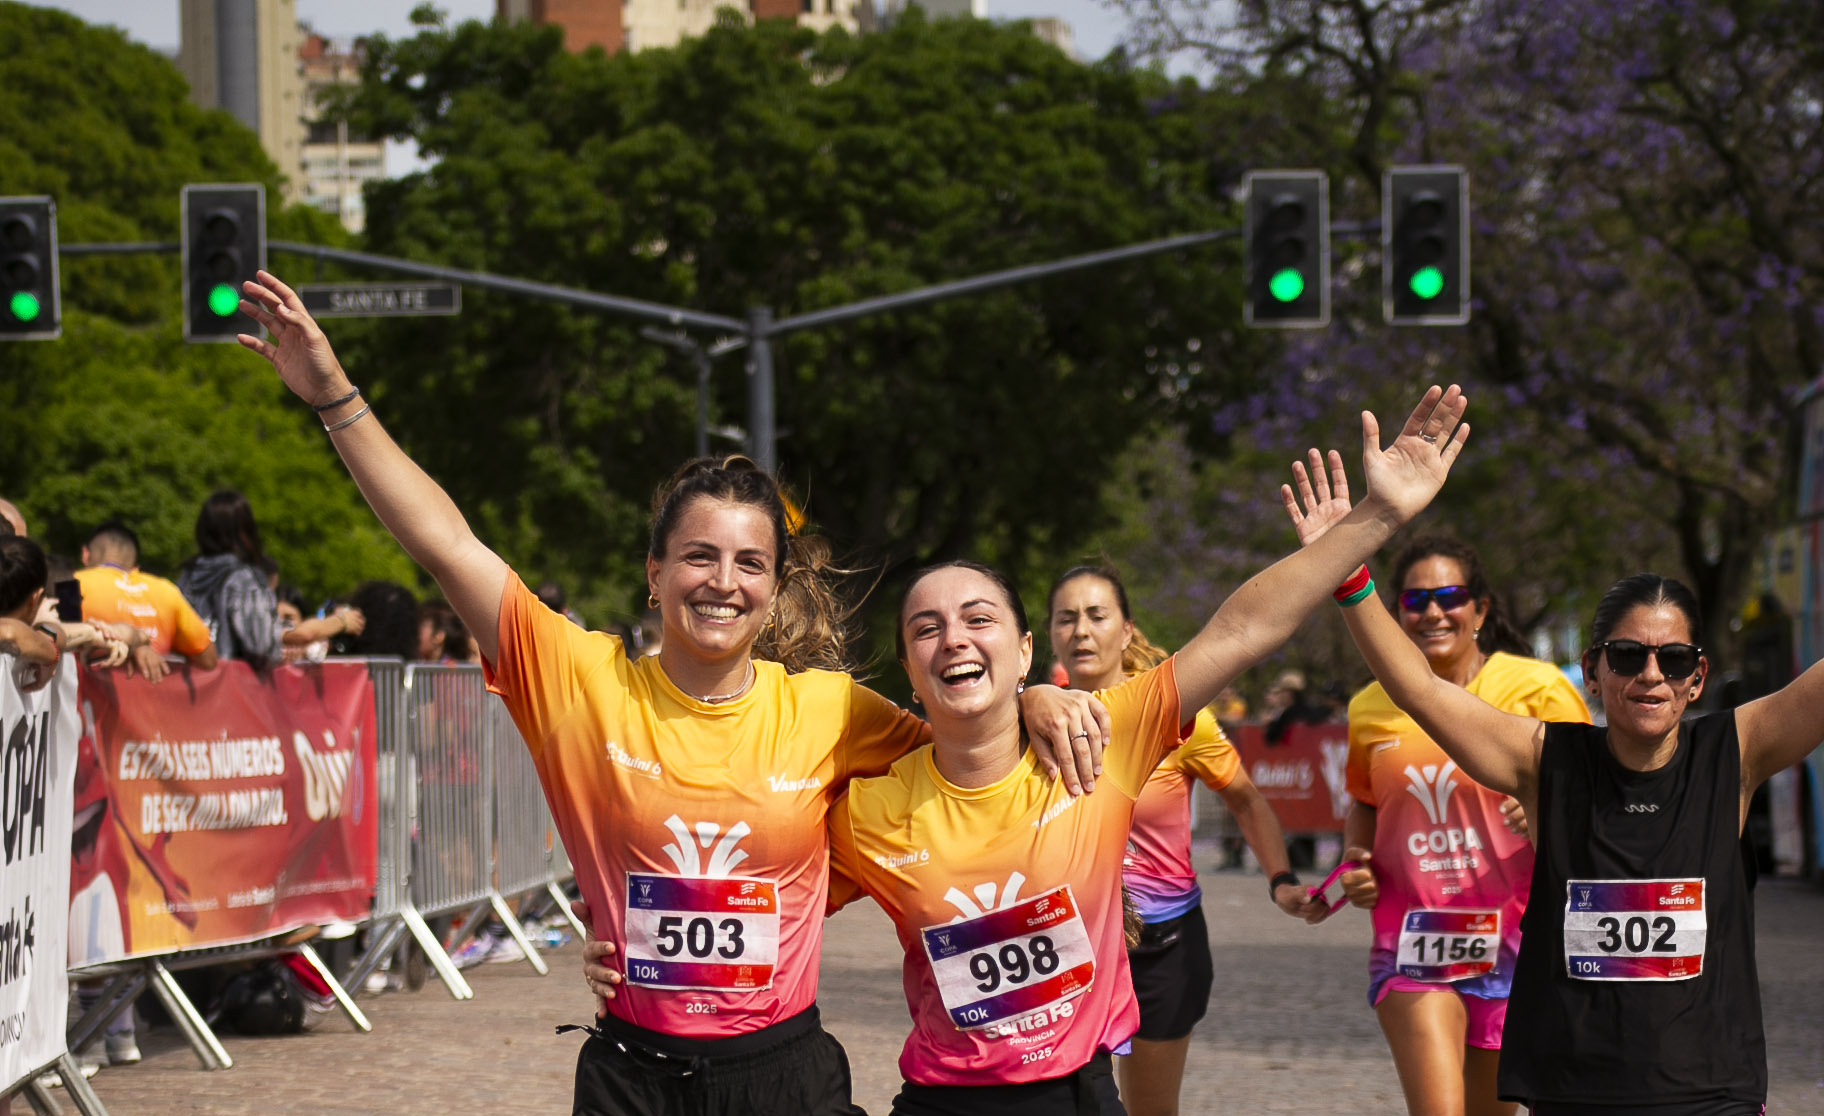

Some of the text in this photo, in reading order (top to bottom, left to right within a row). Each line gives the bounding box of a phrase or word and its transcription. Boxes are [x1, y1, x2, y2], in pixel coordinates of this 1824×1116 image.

[330, 290, 427, 313] SANTA FE
[210, 729, 285, 779] NÚMEROS
[617, 748, 662, 775] Quini 6
[0, 711, 49, 866] OPA
[141, 793, 162, 834] DE
[1408, 827, 1483, 856] COPA
[919, 848, 930, 862] 6
[1418, 854, 1478, 872] Santa Fe
[727, 896, 769, 906] Santa Fe
[1659, 896, 1695, 906] Santa Fe
[1026, 907, 1067, 927] Santa Fe
[656, 916, 745, 959] 503
[1597, 916, 1677, 953] 302
[1412, 935, 1487, 963] 1156
[634, 965, 659, 980] 10k
[969, 935, 1060, 993] 998
[1576, 961, 1601, 973] 10k
[685, 1003, 717, 1014] 2025
[960, 1006, 989, 1024] 10k
[1052, 1001, 1074, 1023] Fe
[1009, 1029, 1056, 1046] PROVINCIA
[1021, 1046, 1053, 1065] 2025
